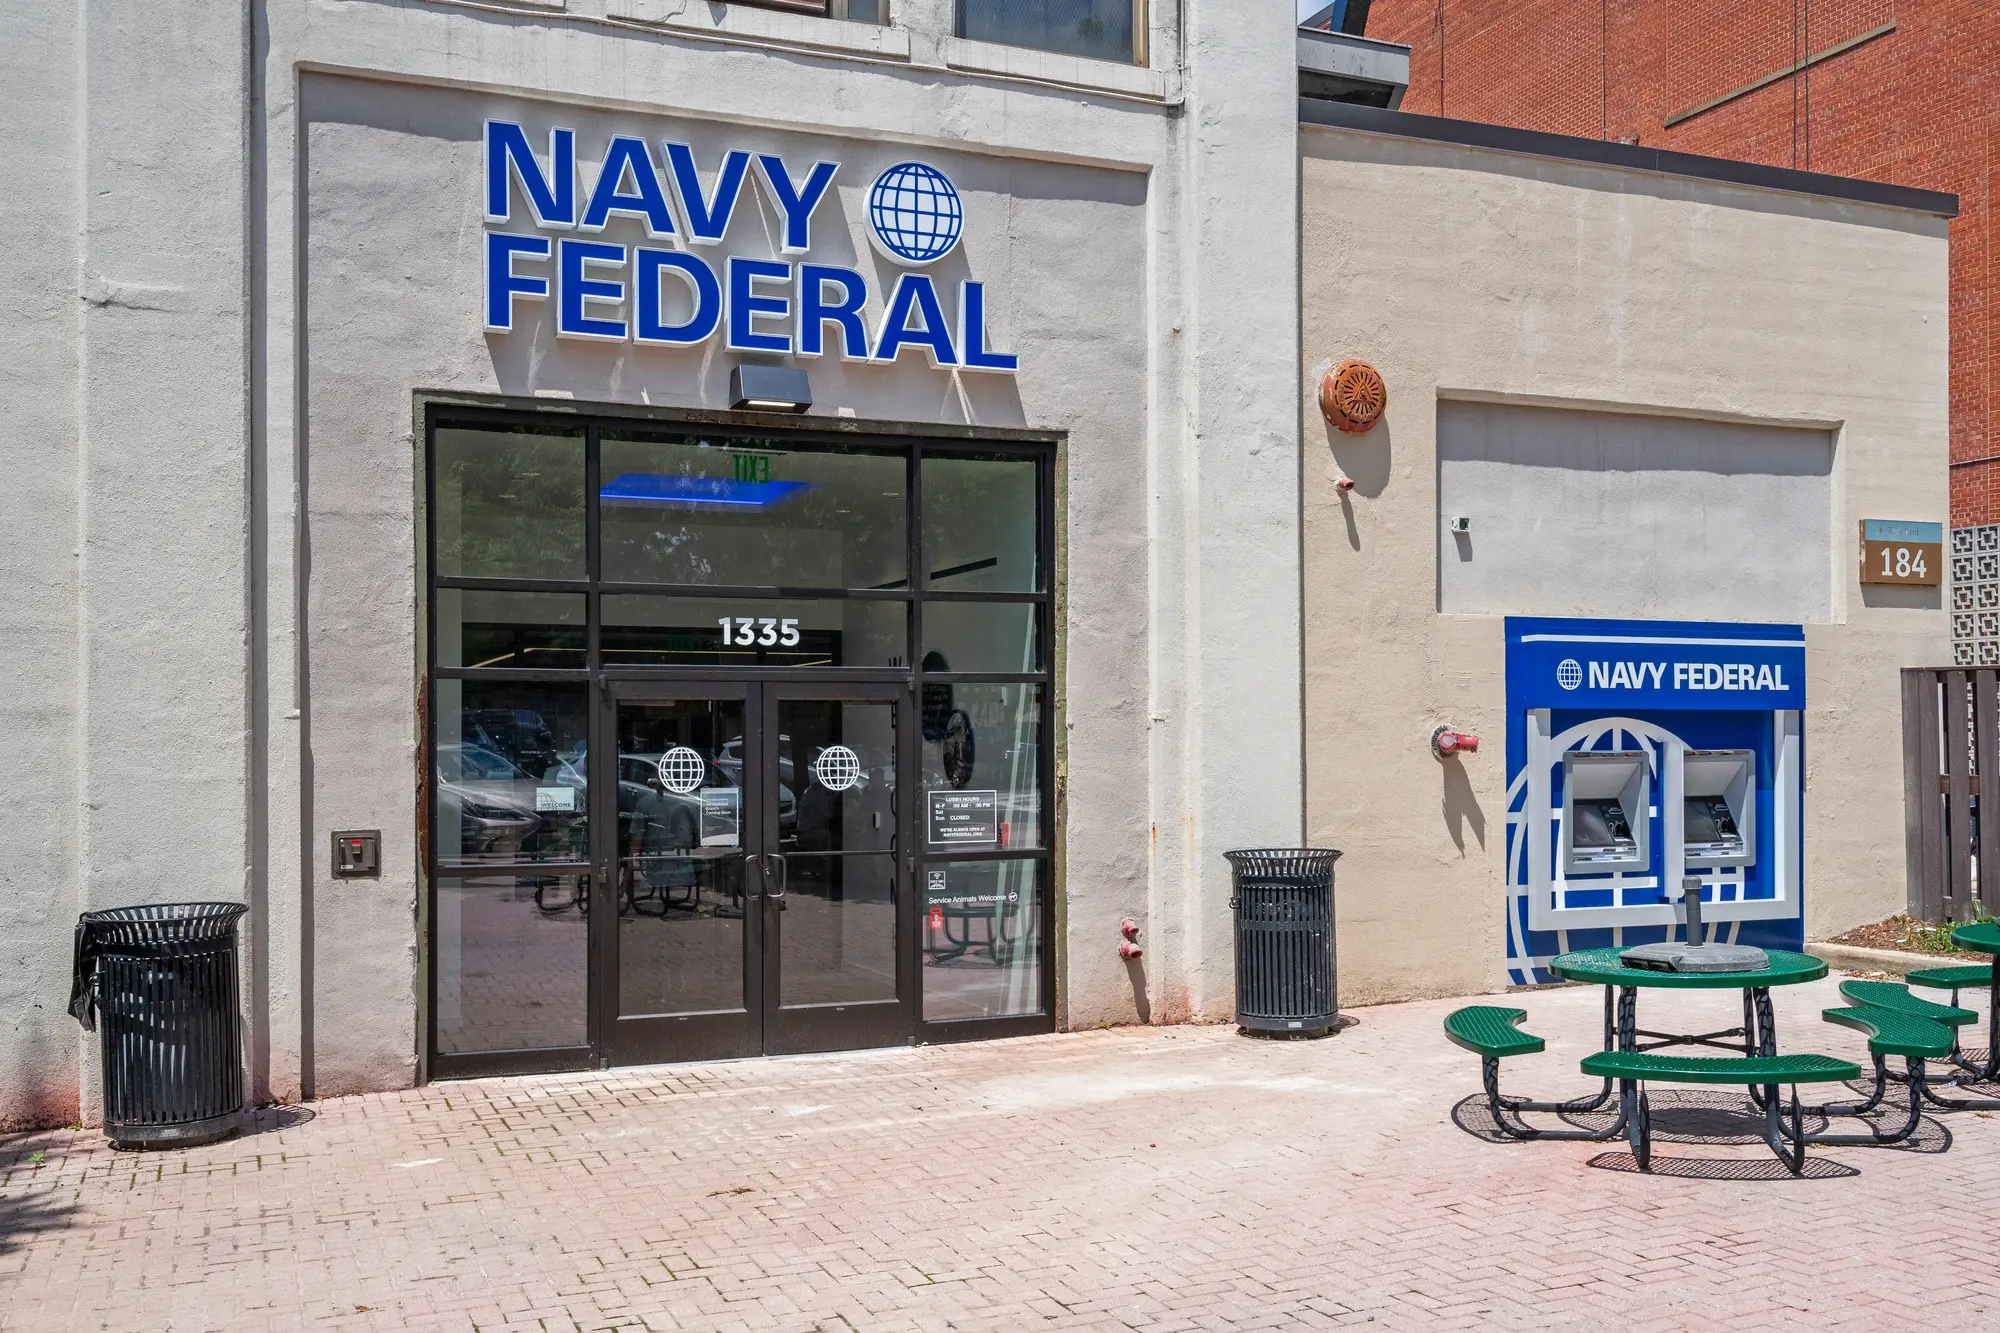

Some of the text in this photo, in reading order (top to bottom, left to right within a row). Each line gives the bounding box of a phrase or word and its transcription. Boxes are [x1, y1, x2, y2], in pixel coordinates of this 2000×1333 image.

[483, 117, 841, 255] NAVY
[483, 228, 1019, 374] FEDERAL
[1881, 547, 1927, 579] 184
[718, 616, 800, 646] 1335
[1588, 661, 1790, 691] NAVY FEDERAL
[952, 895, 977, 903] Animals
[978, 893, 1006, 902] Welcome
